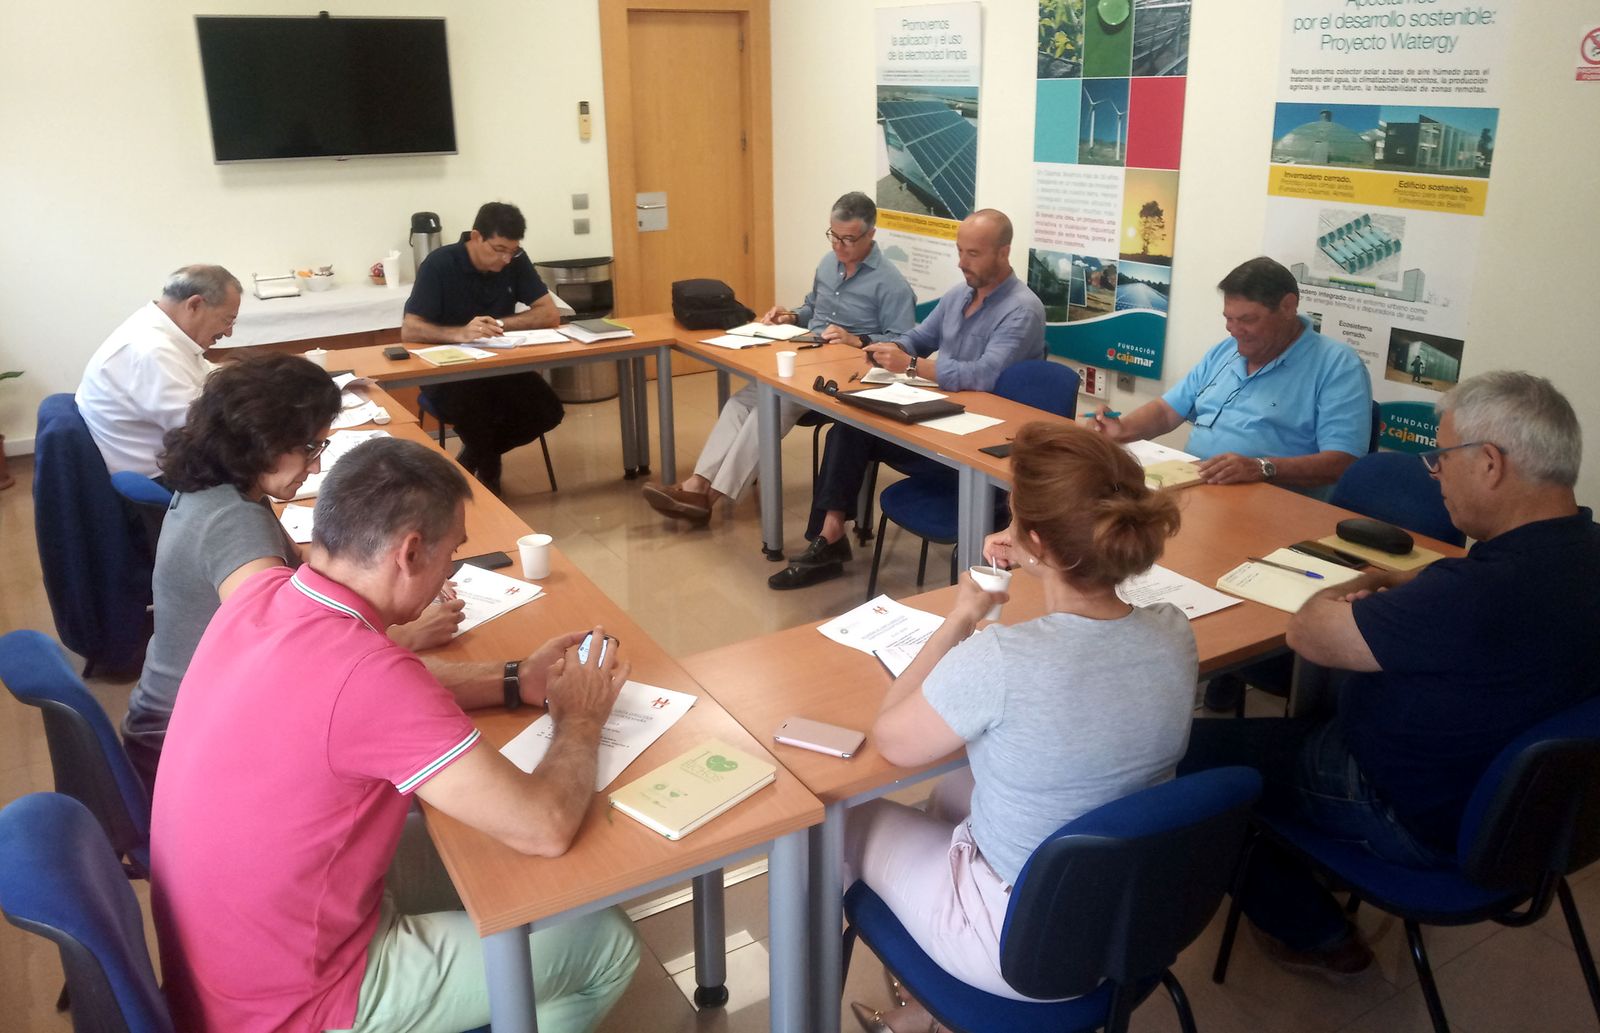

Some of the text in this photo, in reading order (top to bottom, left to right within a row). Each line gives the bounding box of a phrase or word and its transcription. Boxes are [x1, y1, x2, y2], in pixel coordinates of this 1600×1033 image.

[1293, 7, 1497, 33] por el desarrollo sostenible:
[1320, 32, 1459, 54] Proyecto Watergy
[1398, 180, 1426, 190] Edificio
[1338, 319, 1373, 332] Ecosistema
[1116, 351, 1154, 367] cajamar
[1390, 414, 1440, 433] FUNDACIO
[1387, 427, 1437, 448] cajama
